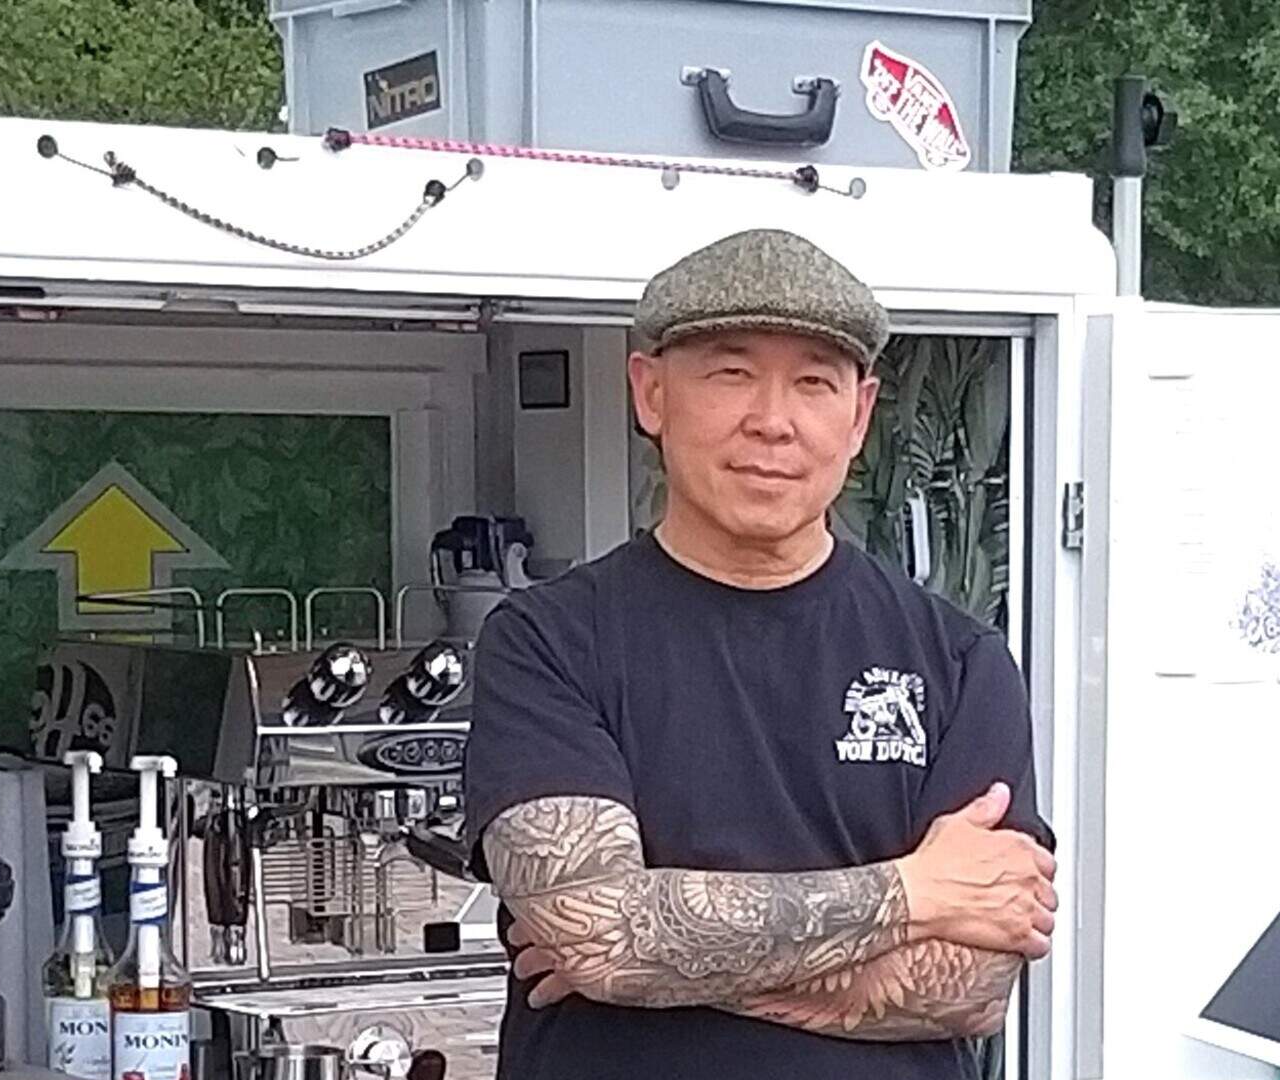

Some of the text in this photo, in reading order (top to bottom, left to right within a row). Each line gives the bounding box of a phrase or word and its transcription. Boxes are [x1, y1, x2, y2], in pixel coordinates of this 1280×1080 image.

[368, 74, 439, 121] NITRO
[835, 740, 873, 761] VON
[60, 1020, 108, 1036] MON
